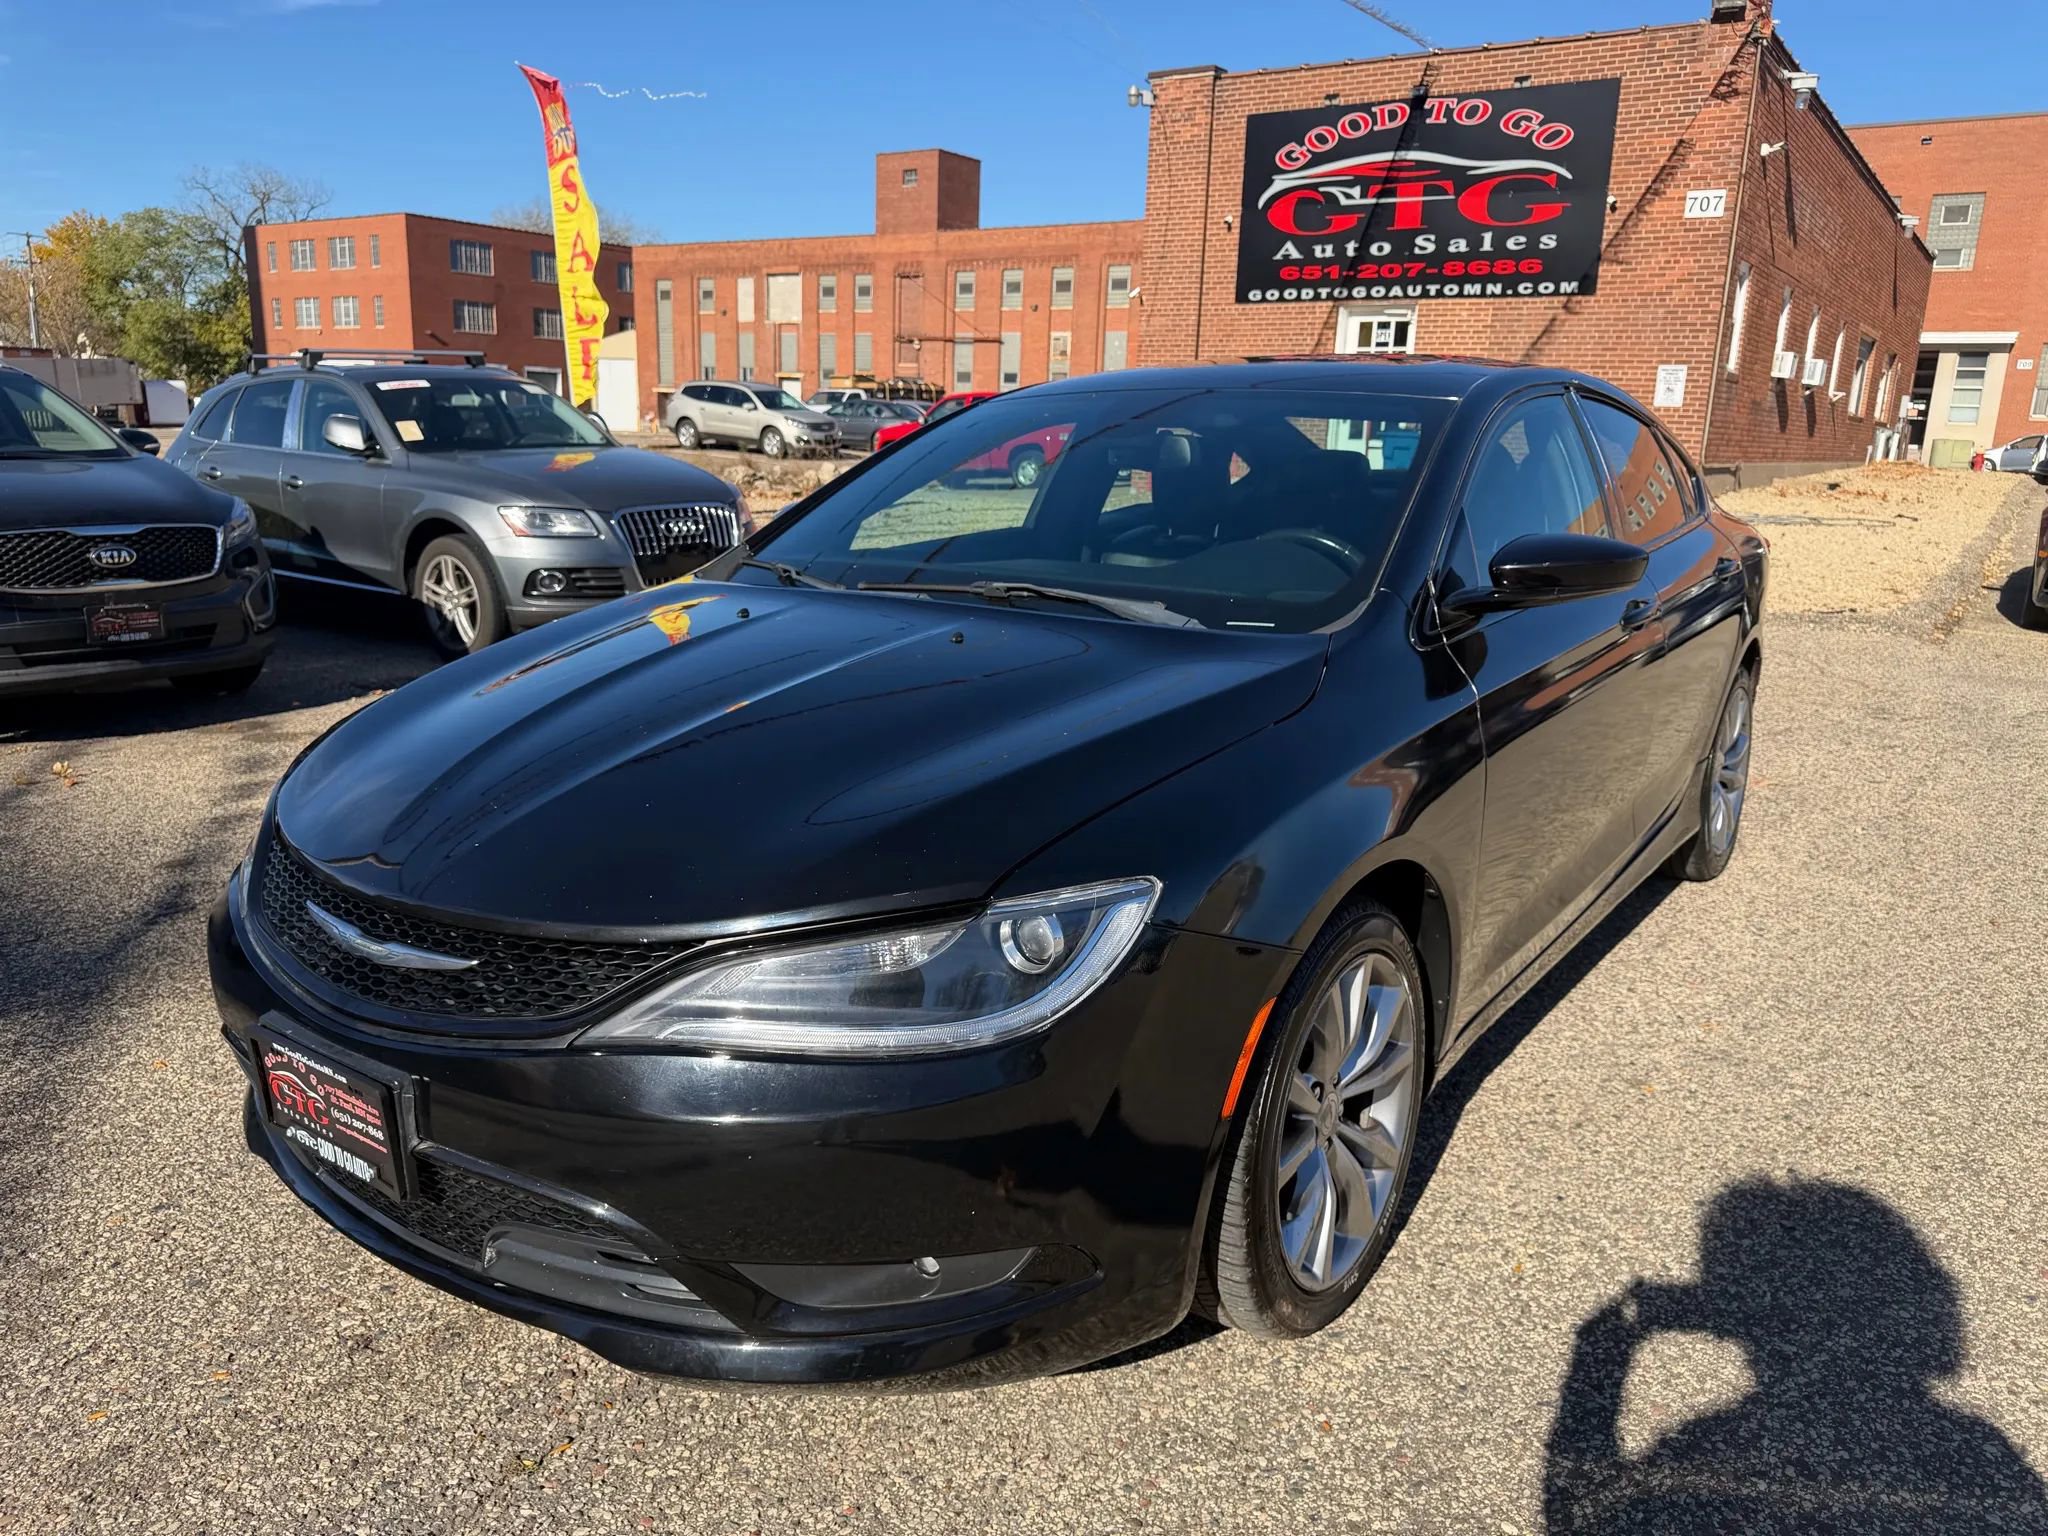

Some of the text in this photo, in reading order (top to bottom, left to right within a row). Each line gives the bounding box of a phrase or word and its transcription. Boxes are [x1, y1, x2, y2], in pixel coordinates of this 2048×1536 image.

[1274, 97, 1575, 171] GOOD TO GO
[1266, 173, 1572, 236] GTG
[1687, 195, 1724, 213] 707
[1272, 230, 1559, 261] Auto Sales
[1278, 258, 1544, 281] 651-207-8686
[1247, 279, 1580, 302] GOODTOGOAUTOMN.COM
[100, 550, 130, 564] KIA
[291, 1058, 306, 1074] TO
[309, 1074, 325, 1097] GO
[271, 1078, 330, 1125] GTG
[276, 1102, 301, 1120] Auto
[330, 1106, 352, 1126] (651)
